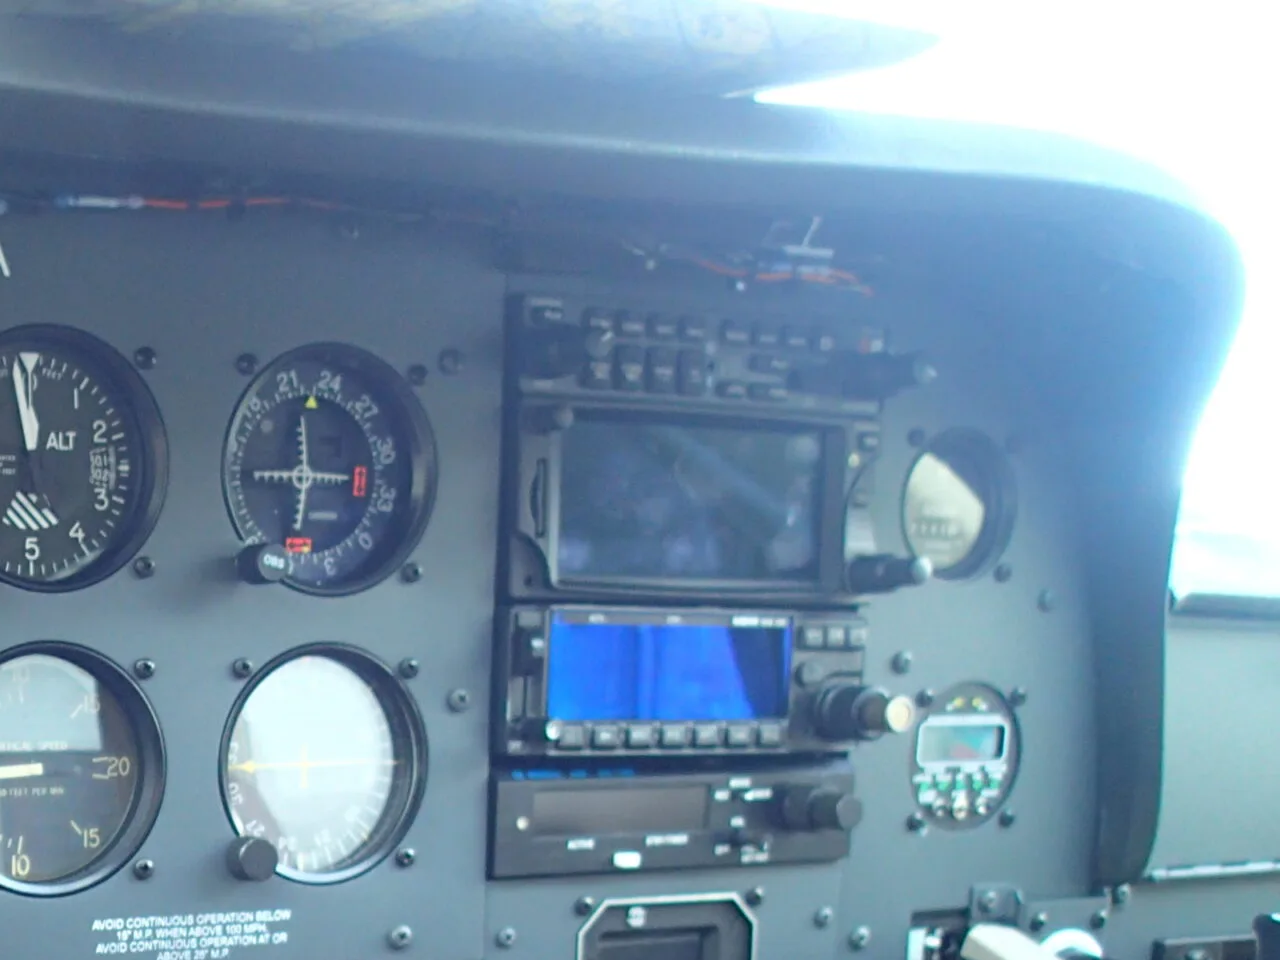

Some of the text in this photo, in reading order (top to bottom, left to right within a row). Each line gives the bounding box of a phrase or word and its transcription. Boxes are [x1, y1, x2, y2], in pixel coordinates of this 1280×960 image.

[277, 370, 300, 392] 21
[319, 370, 342, 392] 24
[46, 431, 77, 451] ALT
[93, 420, 108, 443] 2
[94, 488, 109, 511] 3
[24, 537, 41, 561] 5
[106, 757, 130, 777] 20
[82, 828, 100, 848] 15
[12, 855, 30, 876] 10
[92, 908, 291, 931] AVOID CONTINUOUS OPERATION BELOW
[188, 924, 222, 937] ABOVE
[96, 932, 288, 955] AVOID CONTINUOUS OPERATION AT OR
